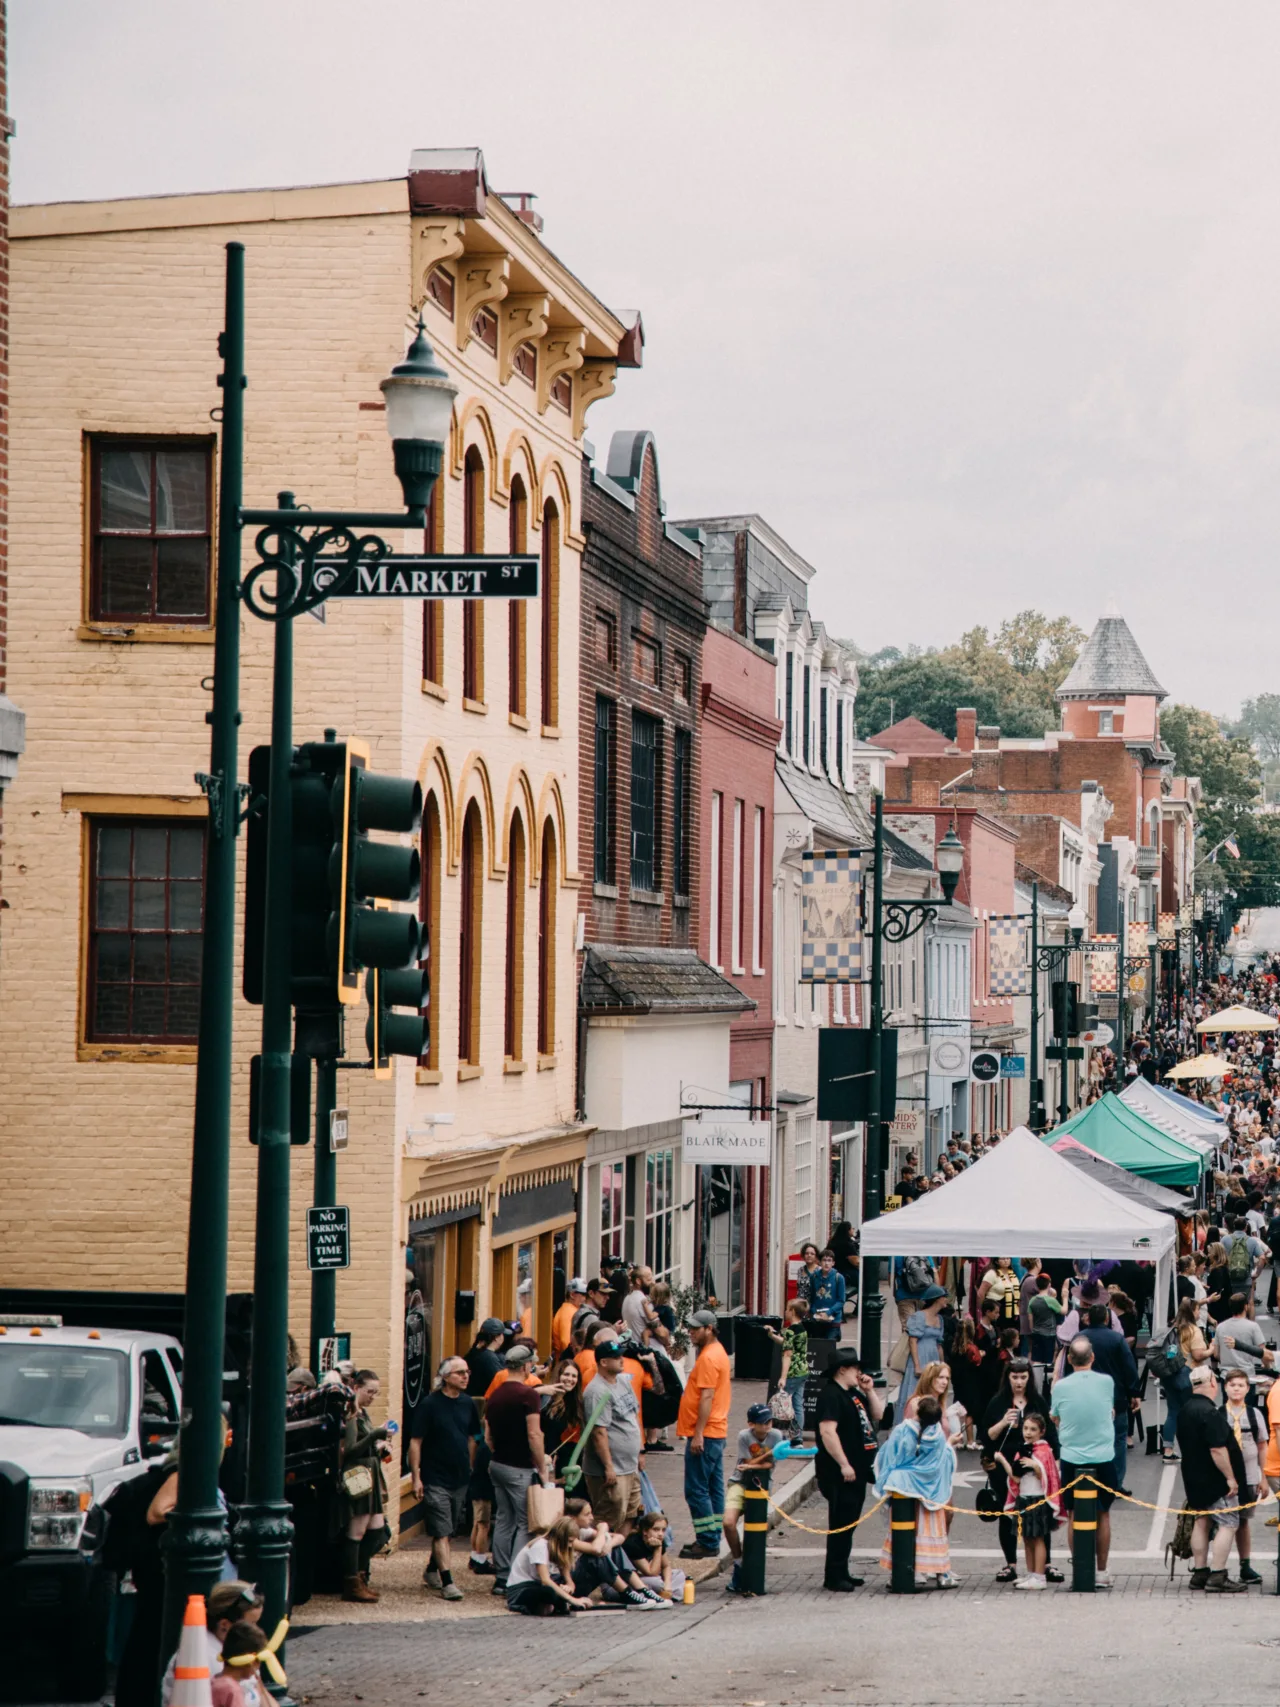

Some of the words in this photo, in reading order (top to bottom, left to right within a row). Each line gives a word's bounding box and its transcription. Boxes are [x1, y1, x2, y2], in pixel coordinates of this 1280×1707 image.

[355, 566, 487, 593] MARKET
[501, 565, 522, 578] ST
[1094, 944, 1119, 953] STREET
[895, 1113, 917, 1122] MID'S
[889, 1121, 918, 1130] NTERY
[686, 1137, 724, 1146] BLAIR
[728, 1138, 766, 1147] MADE
[319, 1212, 336, 1222] NO
[310, 1223, 347, 1233] PARKING
[317, 1234, 339, 1244] ANY
[315, 1245, 342, 1256] TIME
